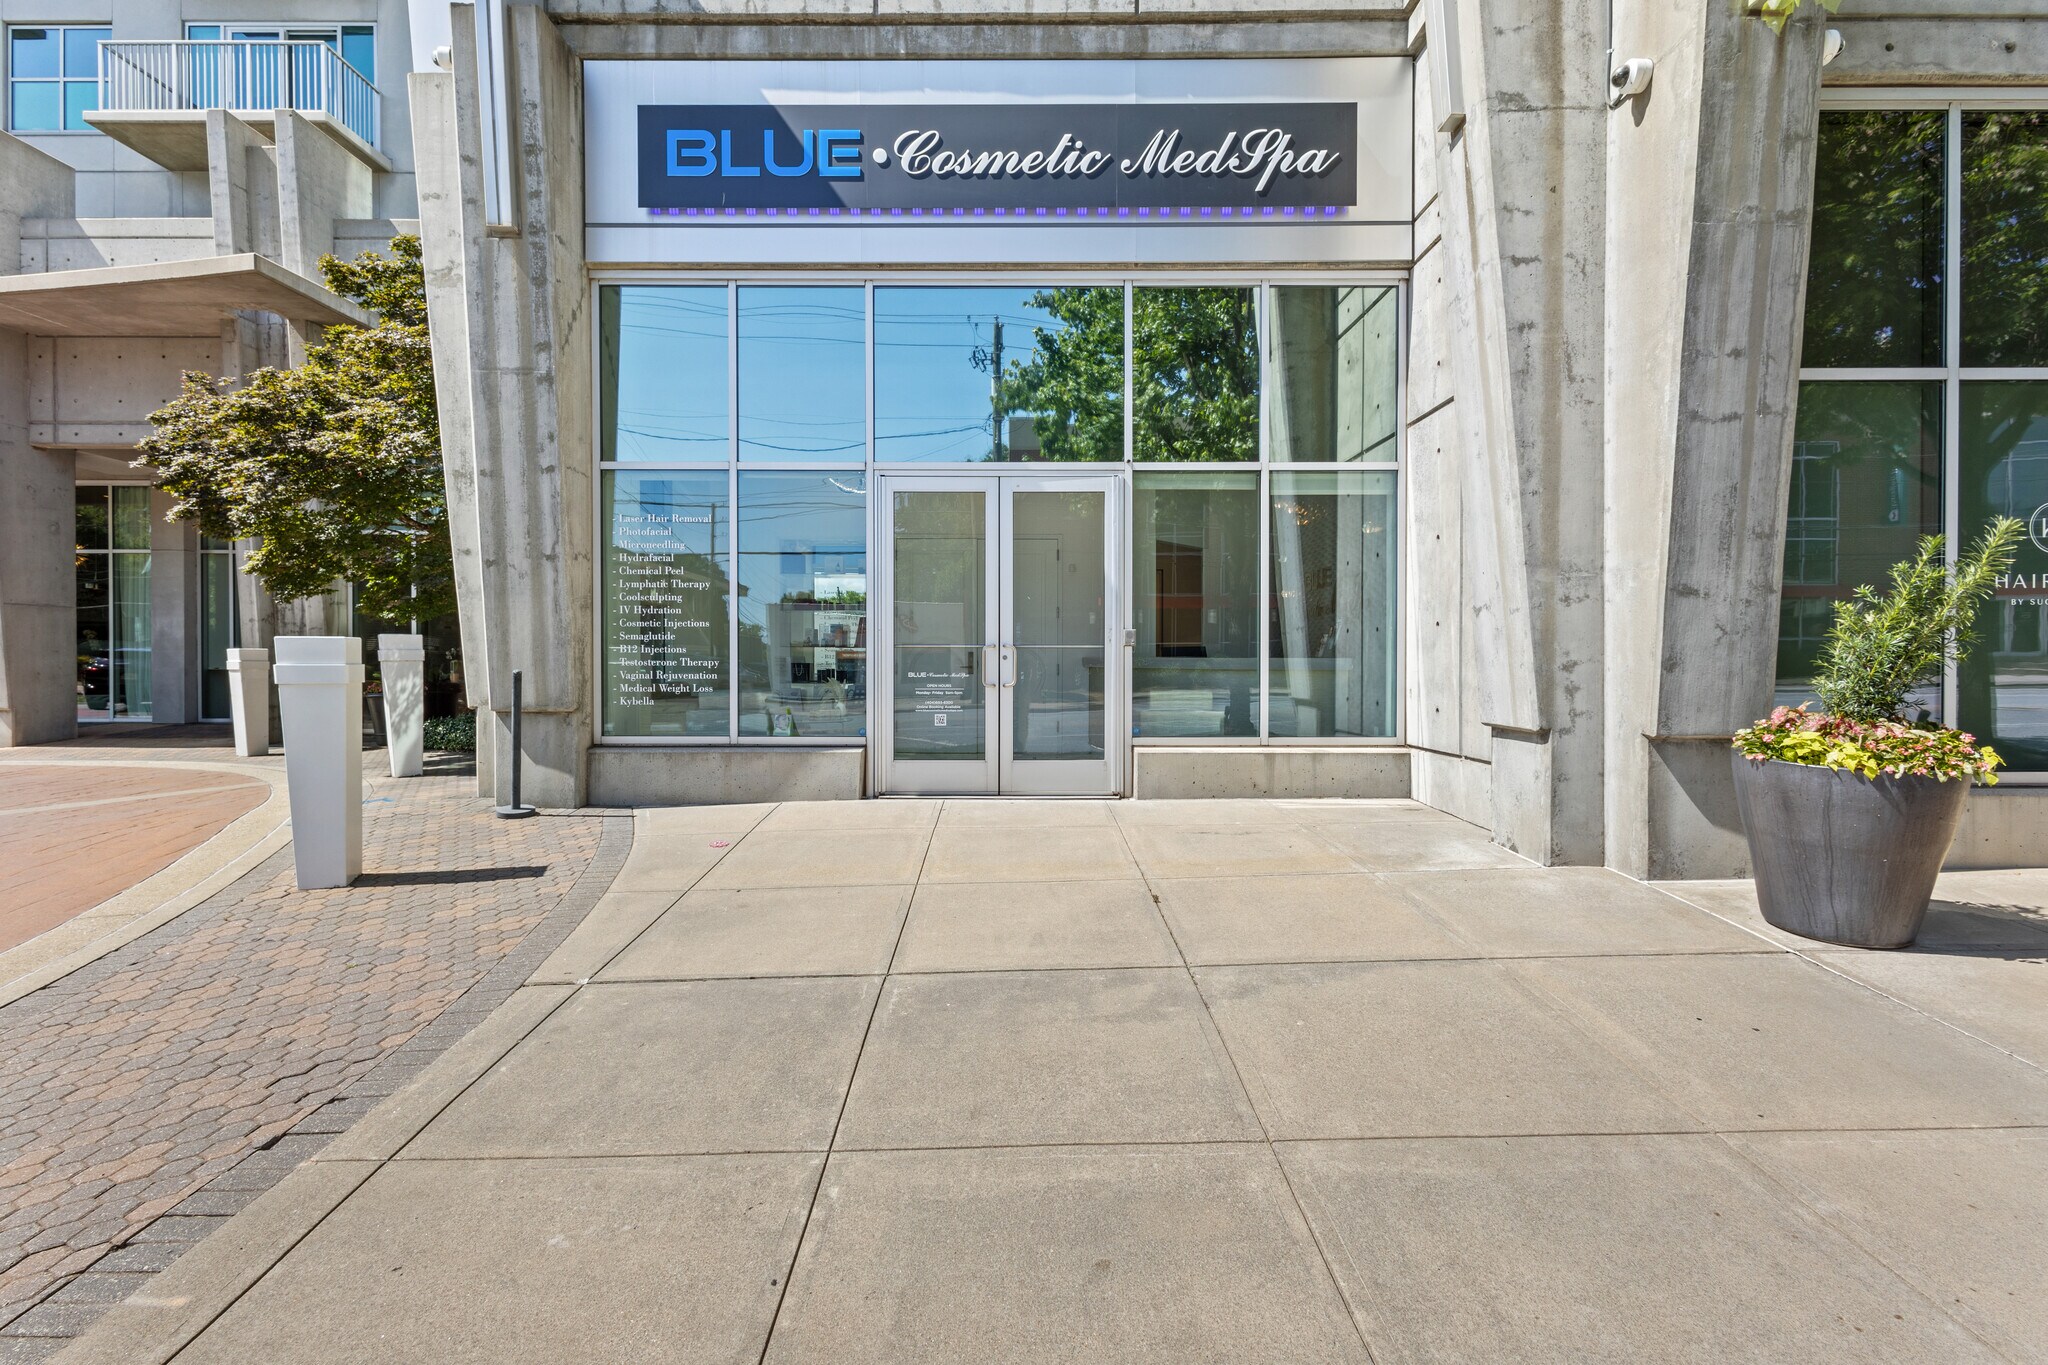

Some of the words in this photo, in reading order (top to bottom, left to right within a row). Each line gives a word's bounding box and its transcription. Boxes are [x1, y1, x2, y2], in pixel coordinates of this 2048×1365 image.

[666, 129, 861, 177] BLUE
[893, 129, 1111, 175] Cosmetic
[1121, 128, 1340, 192] MedSpa
[619, 514, 646, 523] Laser
[647, 514, 670, 523] Hair
[672, 514, 713, 523] Removal
[619, 527, 672, 536] Photofacial
[619, 540, 686, 551] Microneedling
[619, 553, 675, 564] Hydrafacial
[619, 566, 662, 576] Chemical
[665, 566, 684, 576] Peel
[619, 579, 669, 591] Lymphatic
[671, 579, 711, 591] Therapy
[619, 592, 683, 604] Coolsculpting
[2011, 598, 2024, 606] BY
[619, 605, 631, 615] IV
[634, 605, 682, 616] Hydration
[619, 618, 661, 628] Cosmetic
[664, 618, 710, 629] Injections
[619, 631, 676, 643] Semaglutide
[619, 644, 638, 654] B12
[641, 644, 687, 655] Injections
[619, 657, 678, 667] Testosterone
[680, 657, 720, 668] Therapy
[619, 670, 653, 682] Vaginal
[656, 670, 718, 682] Rejuvenation
[619, 684, 656, 693] Medical
[659, 684, 690, 695] Weight
[693, 684, 713, 693] Loss
[619, 696, 655, 707] Kybella
